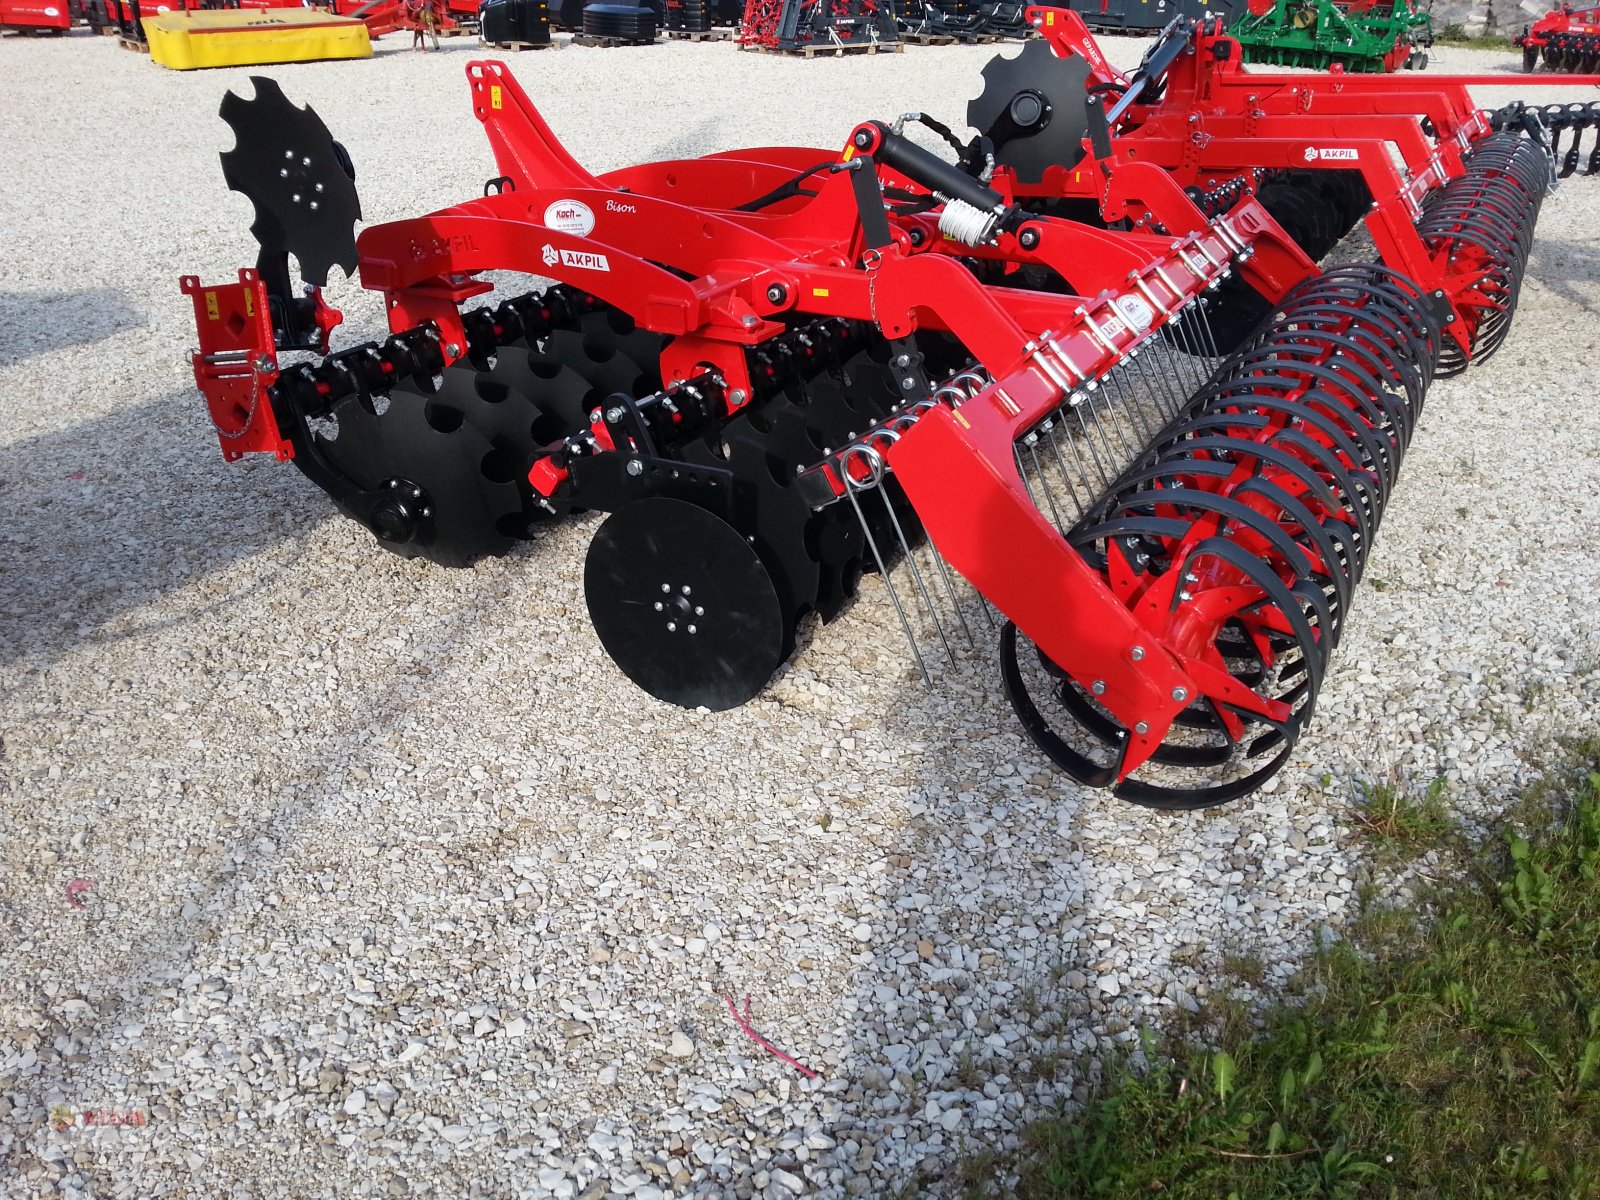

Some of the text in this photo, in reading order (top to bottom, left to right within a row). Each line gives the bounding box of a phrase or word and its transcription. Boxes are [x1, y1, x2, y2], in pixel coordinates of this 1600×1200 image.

[1324, 150, 1354, 158] AKPIL
[606, 199, 637, 214] Bison
[566, 252, 604, 269] AKPIL
